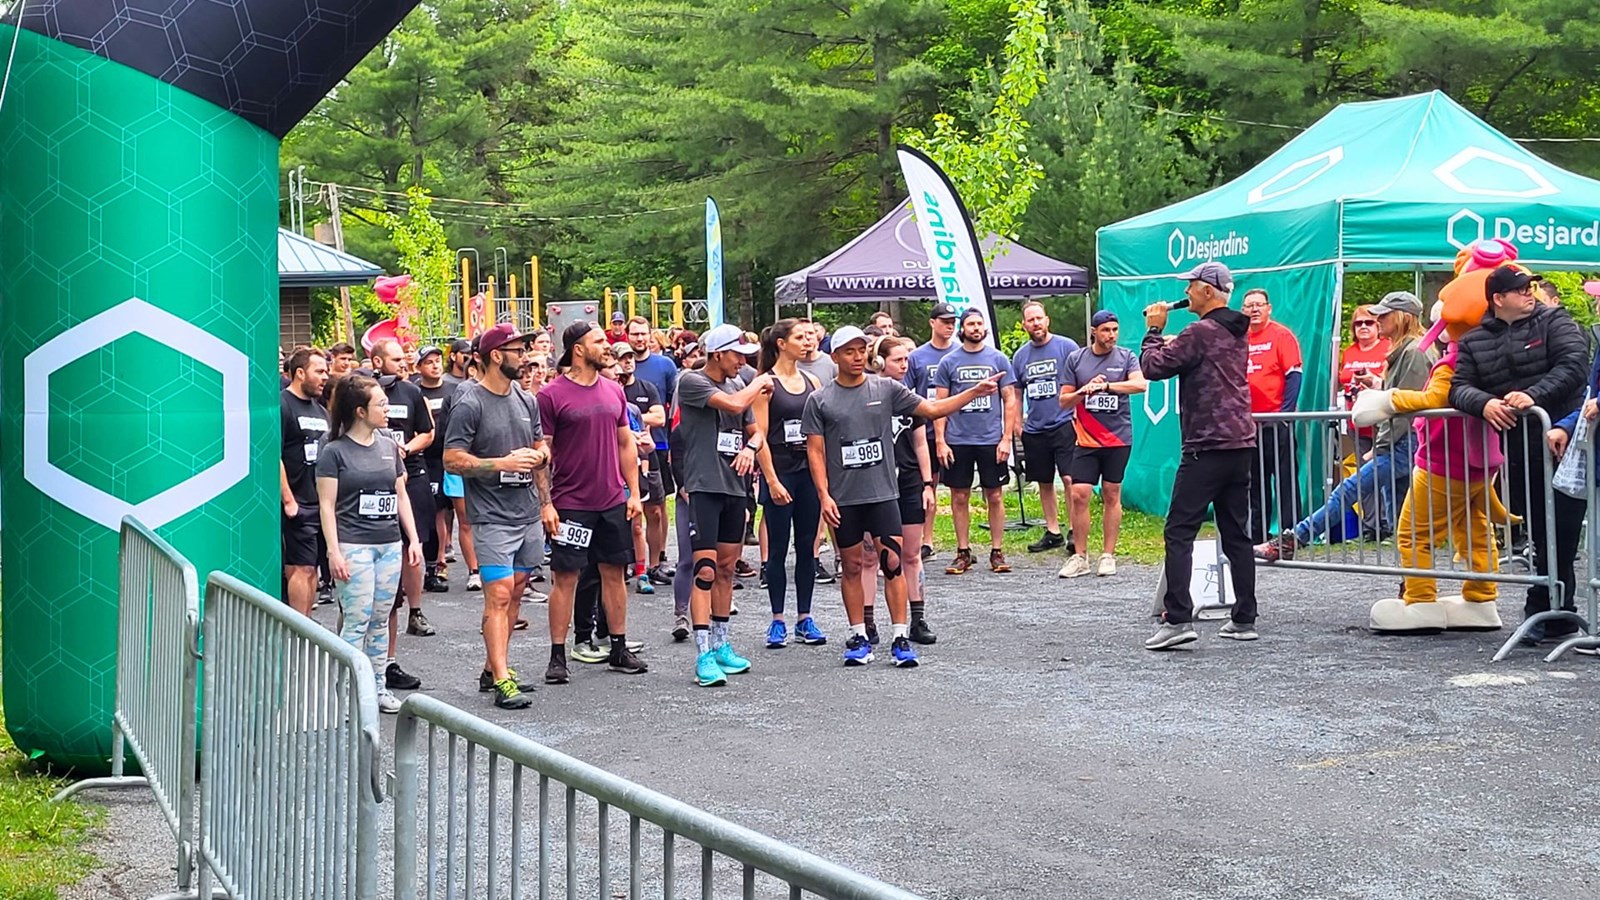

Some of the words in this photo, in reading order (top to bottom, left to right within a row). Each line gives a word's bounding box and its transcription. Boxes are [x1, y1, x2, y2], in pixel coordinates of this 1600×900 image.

[1187, 230, 1249, 263] Desjardins
[960, 369, 990, 380] RCM
[1028, 362, 1054, 376] RCM
[1037, 382, 1054, 394] 909
[1098, 396, 1116, 408] 852
[858, 444, 880, 461] 989
[378, 496, 396, 513] 987
[567, 527, 589, 545] 993
